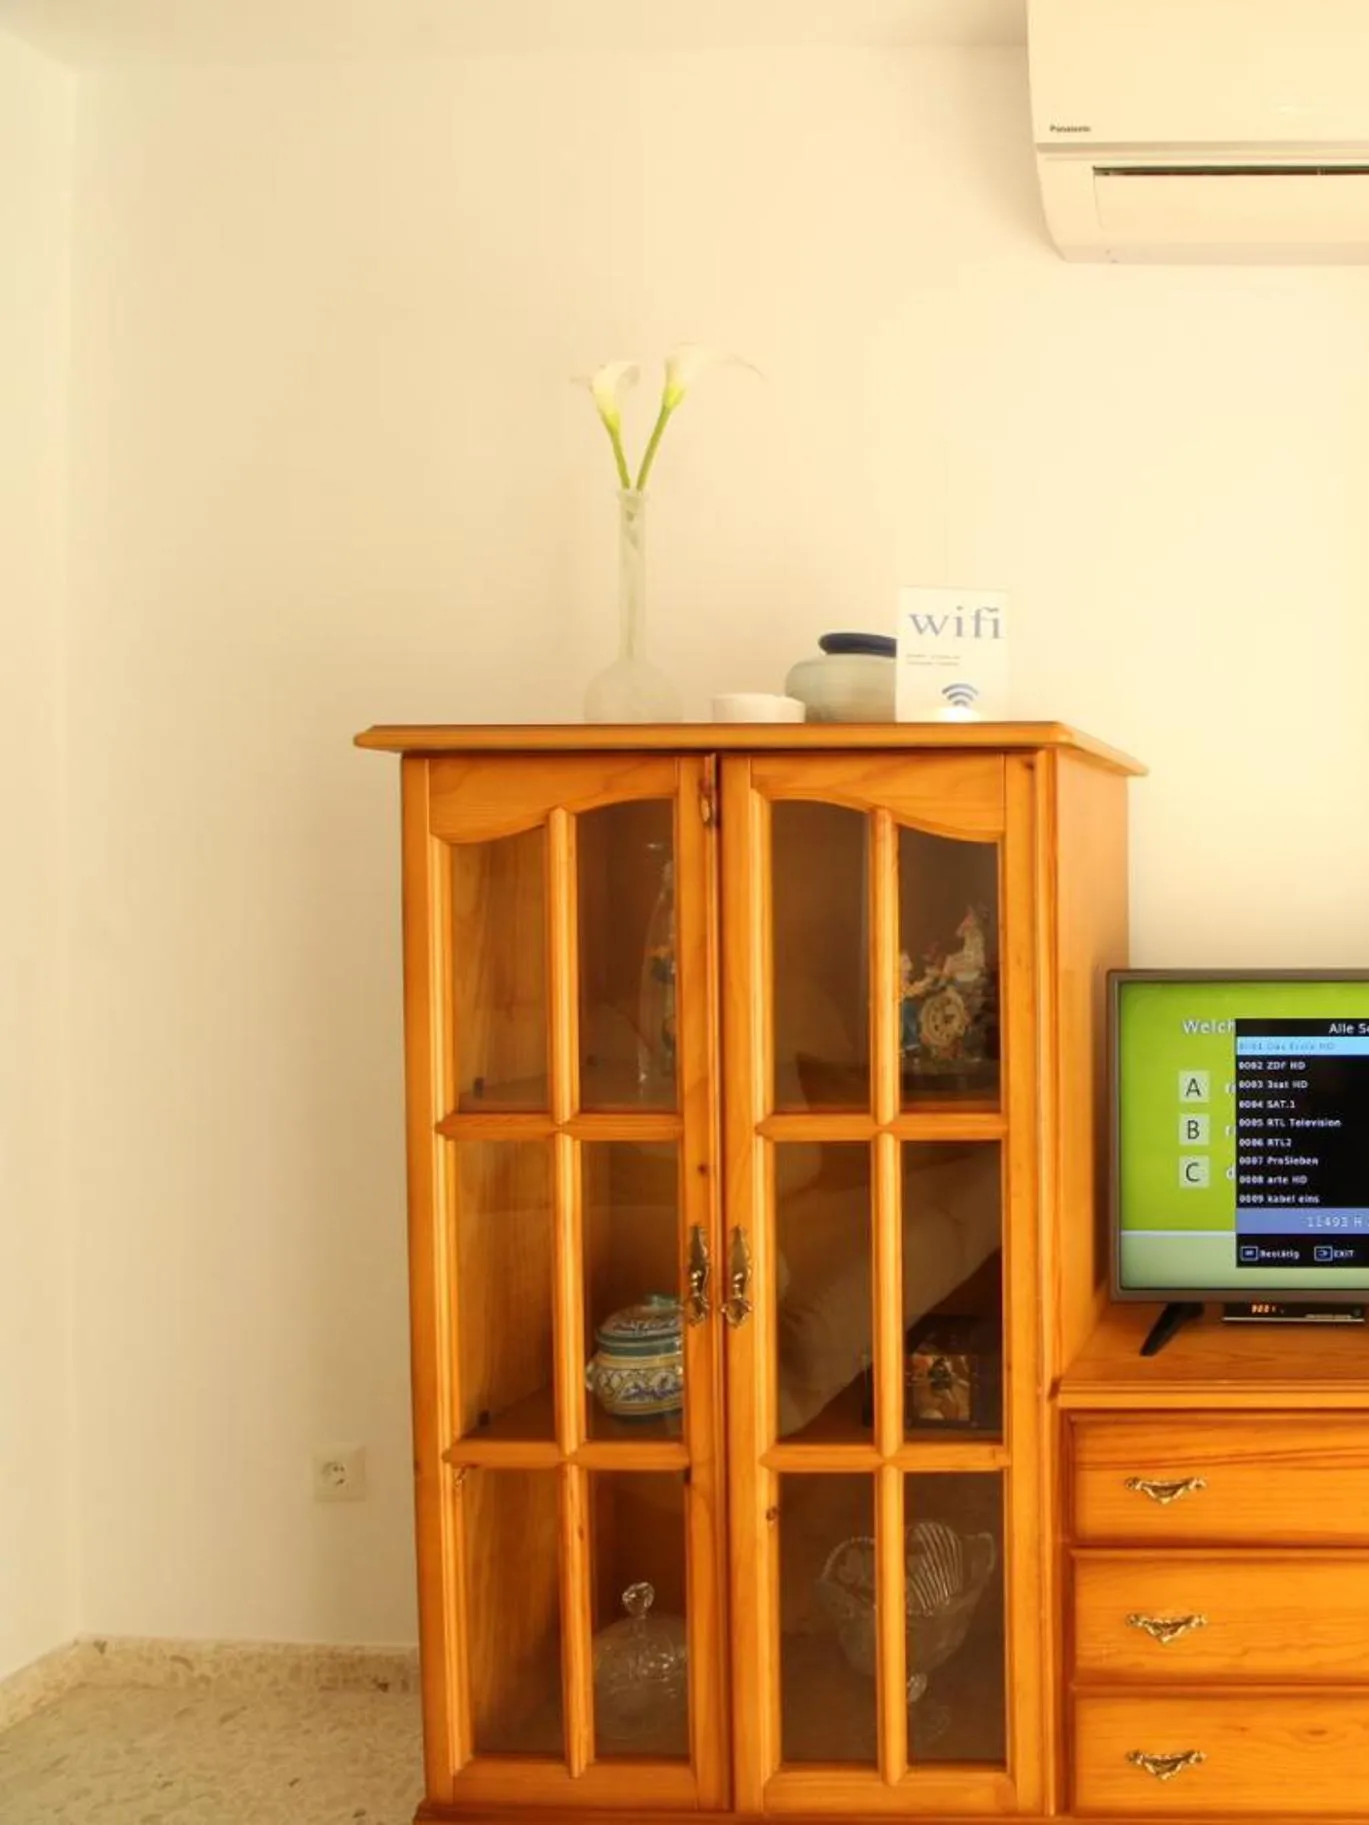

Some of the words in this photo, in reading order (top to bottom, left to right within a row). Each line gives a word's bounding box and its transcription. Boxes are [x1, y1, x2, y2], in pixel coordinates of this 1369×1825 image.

[908, 605, 1005, 639] wifi
[1329, 1023, 1354, 1034] Alle
[1185, 1077, 1202, 1097] A
[1187, 1120, 1200, 1140] B
[1185, 1162, 1200, 1182] C
